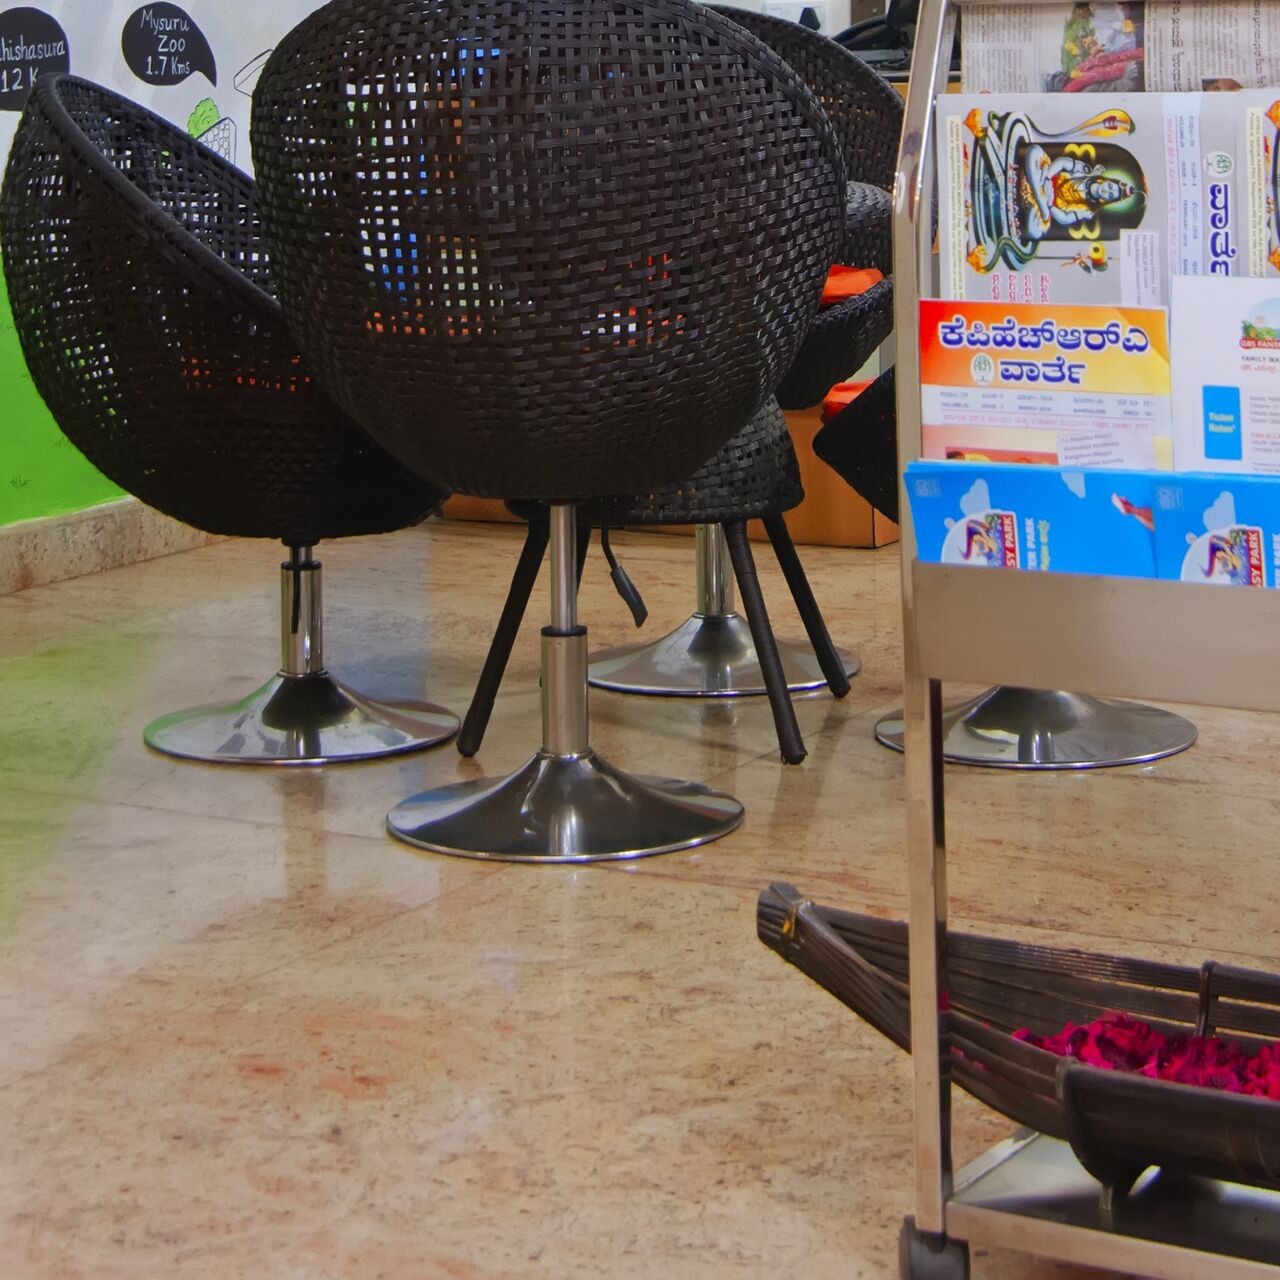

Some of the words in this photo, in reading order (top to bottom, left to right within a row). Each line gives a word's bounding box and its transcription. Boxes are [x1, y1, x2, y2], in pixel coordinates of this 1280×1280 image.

[140, 8, 190, 35] Mysuru
[158, 35, 186, 52] Zoo
[146, 56, 167, 75] 1.7
[171, 56, 190, 75] Kms
[1, 68, 23, 92] 12
[1000, 356, 1086, 384] ವಾರ್ತೆ
[1241, 355, 1267, 363] FAMILY
[1003, 516, 1014, 548] PARK
[1025, 518, 1035, 549] PARK
[1248, 531, 1260, 565] PARK
